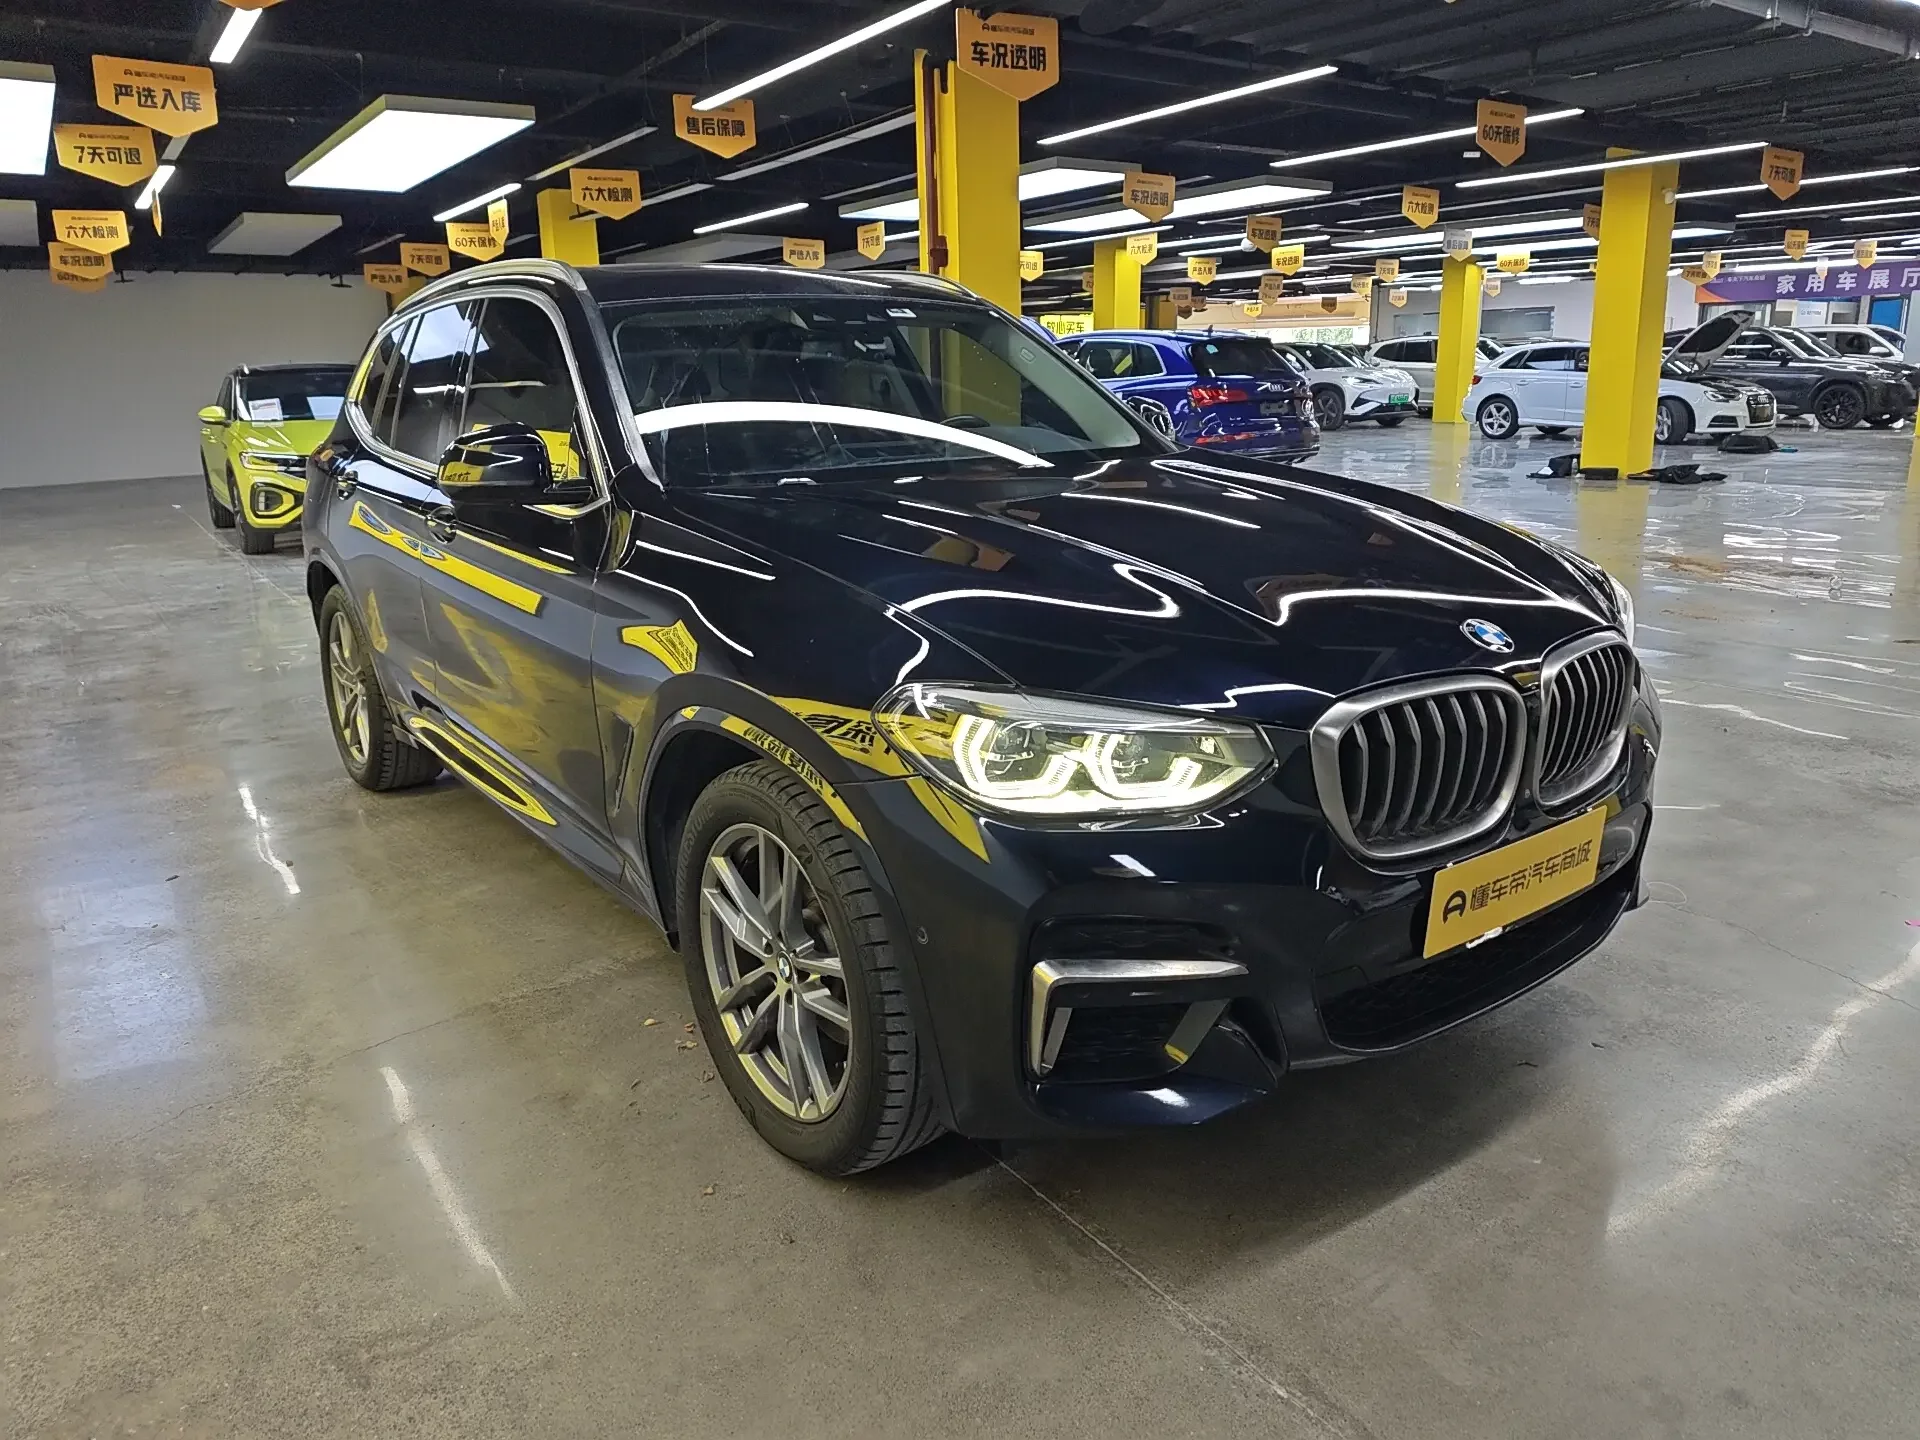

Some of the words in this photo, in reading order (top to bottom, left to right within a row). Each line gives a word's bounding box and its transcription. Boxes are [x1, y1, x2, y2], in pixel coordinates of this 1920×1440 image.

[971, 41, 1047, 71] 车况透明
[113, 83, 202, 112] 严选入库
[686, 116, 746, 137] 售后保障
[1482, 125, 1520, 145] 60天保修
[73, 146, 142, 165] 7天可退
[1768, 165, 1795, 183] 7天可退
[581, 187, 632, 203] 六大检测
[1130, 189, 1169, 206] 车况透明
[65, 225, 119, 239] 六大检测
[862, 235, 881, 249] 7天可退
[59, 255, 105, 267] 车况透明
[409, 254, 443, 265] 7天可退
[789, 249, 820, 261] 严选入库
[1275, 256, 1300, 266] 车况透明
[1776, 268, 1920, 294] 家用车展厅
[1470, 839, 1593, 911] 懂车帝汽车商城
